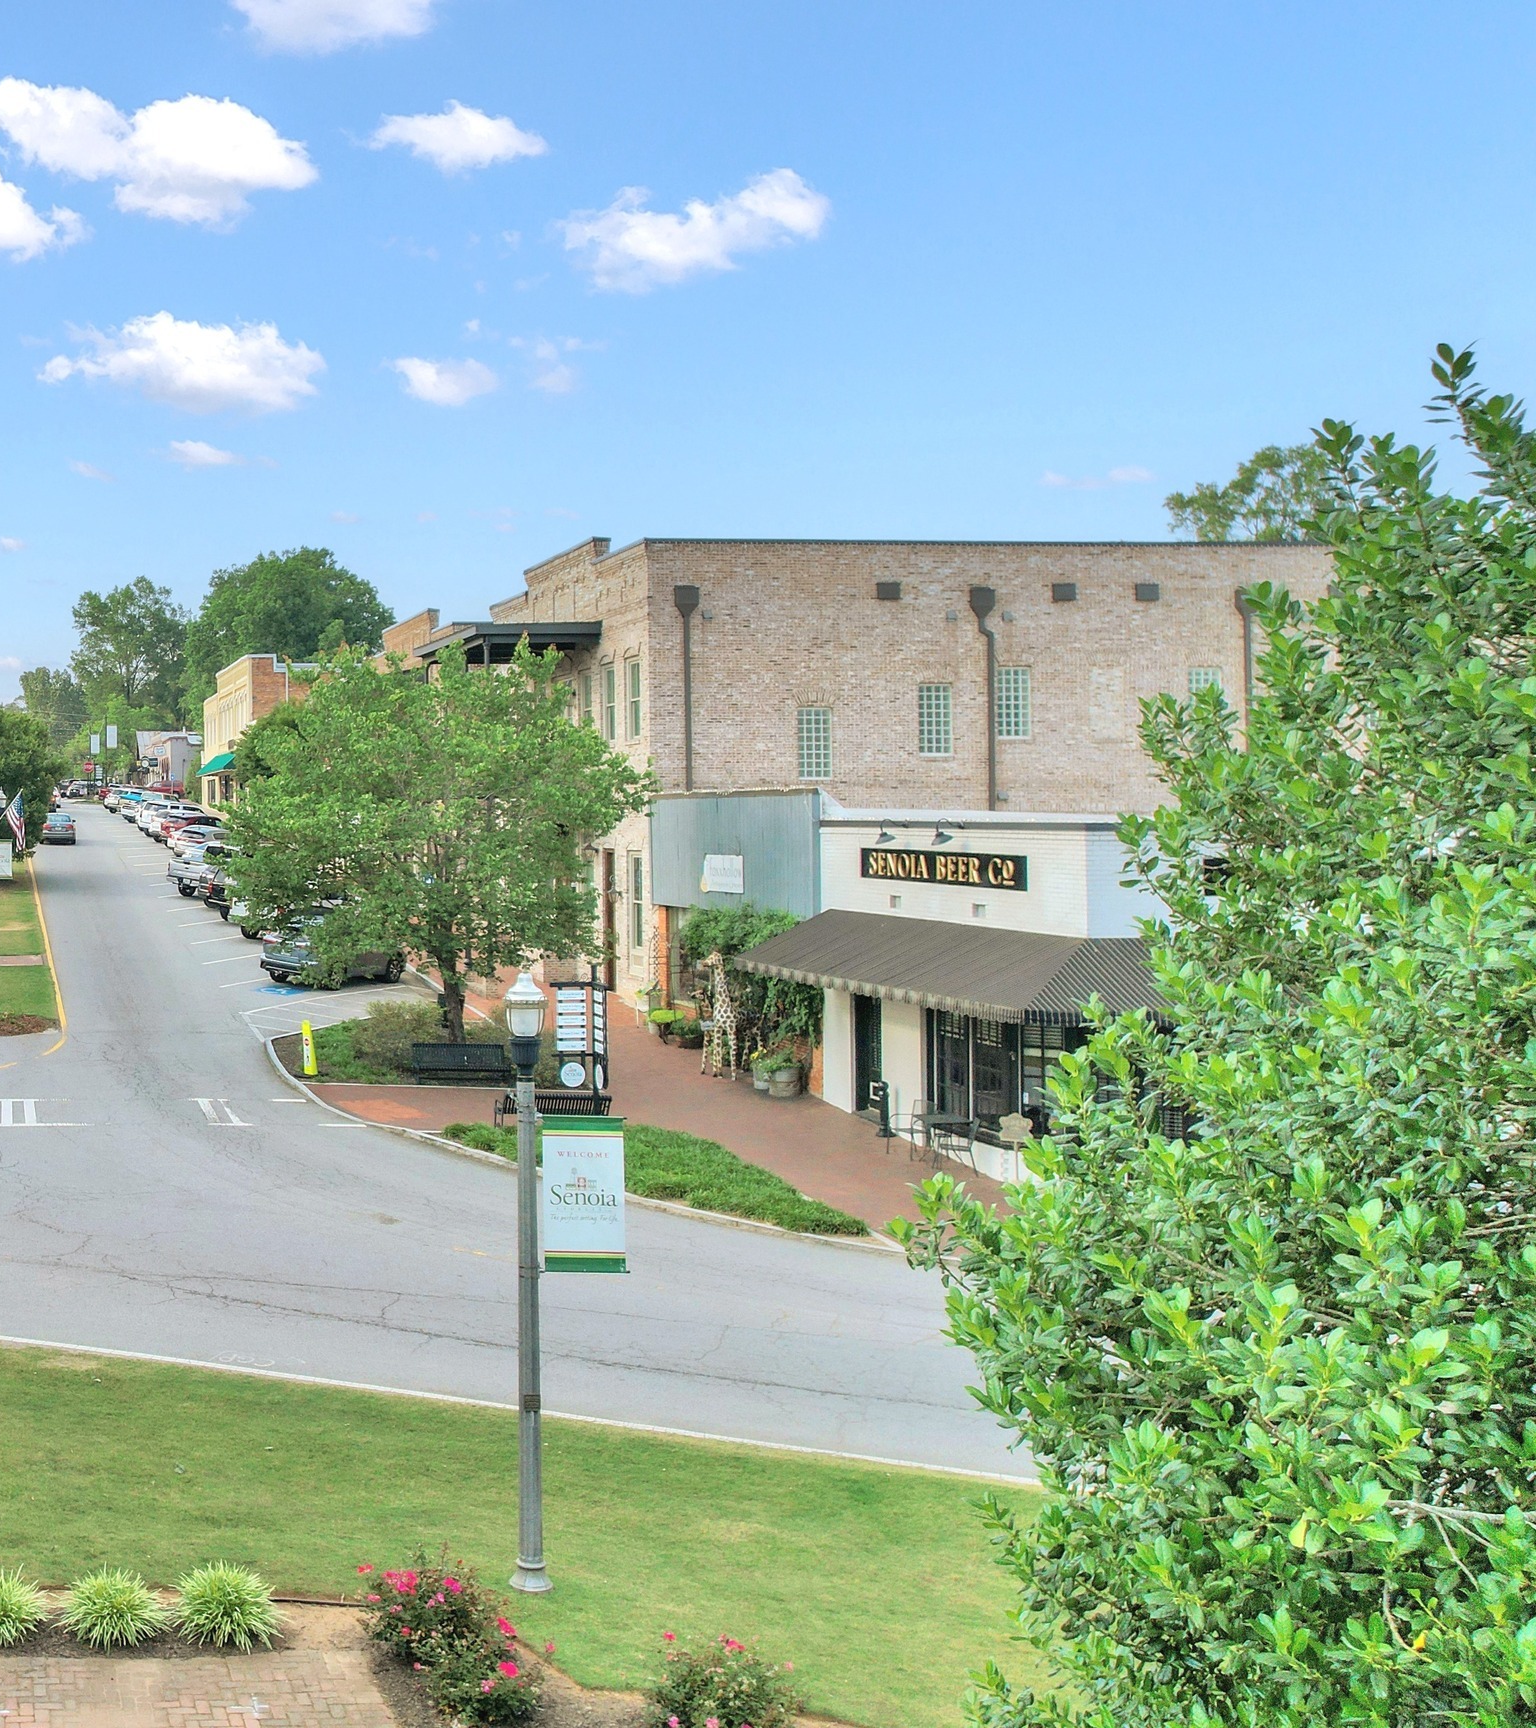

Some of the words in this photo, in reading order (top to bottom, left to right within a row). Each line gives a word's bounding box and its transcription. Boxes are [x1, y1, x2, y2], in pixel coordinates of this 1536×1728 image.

[868, 851, 930, 879] SENOIA
[935, 854, 982, 884] BEER
[557, 1151, 610, 1159] WELCOME
[550, 1184, 618, 1207] Senoia
